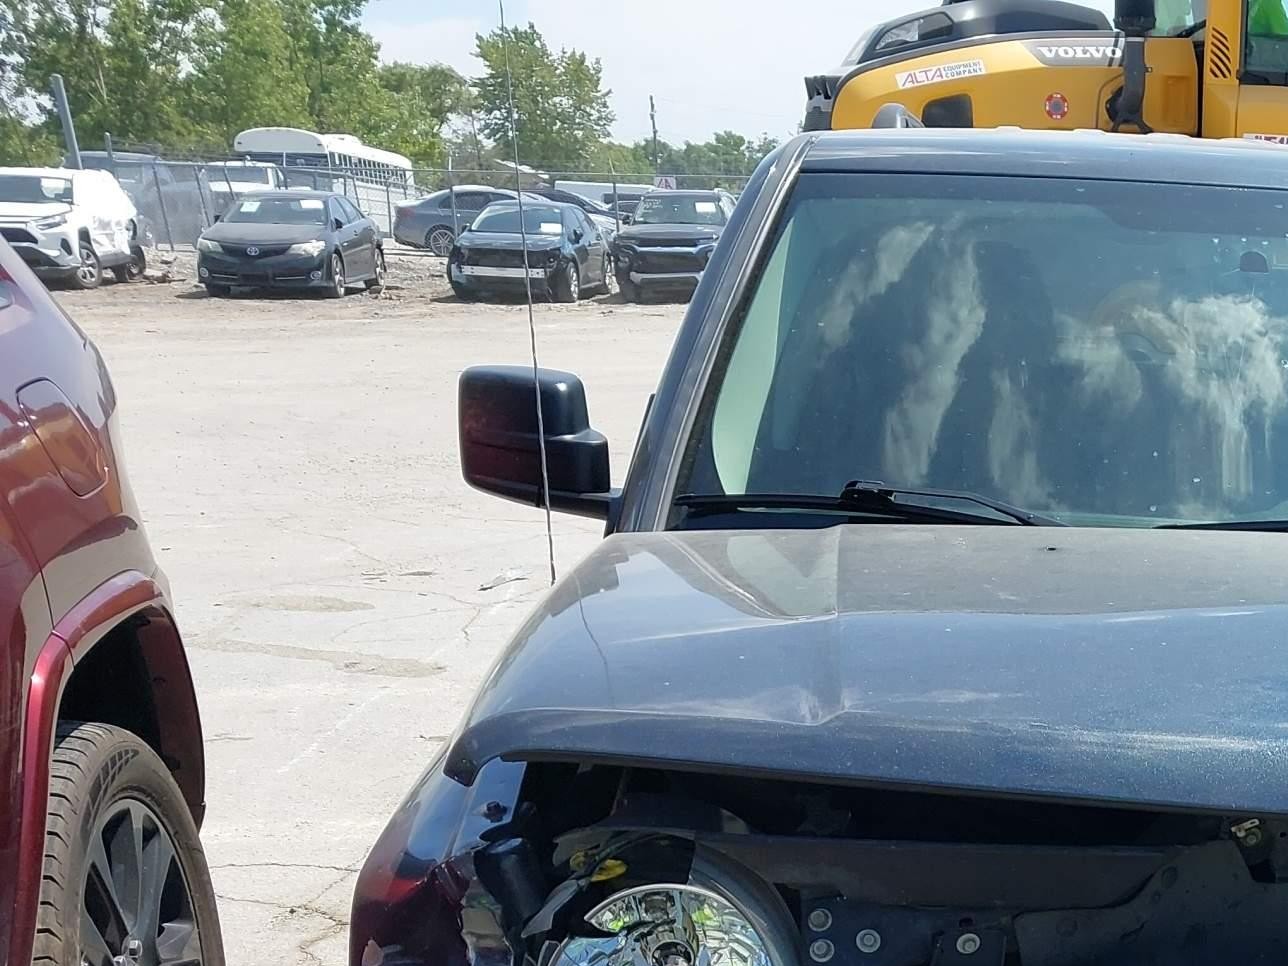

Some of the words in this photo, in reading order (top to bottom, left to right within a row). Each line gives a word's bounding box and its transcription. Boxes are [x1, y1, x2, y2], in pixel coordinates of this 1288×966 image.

[1037, 46, 1122, 58] VOLVO
[943, 60, 981, 72] EQUIPMENT
[902, 67, 944, 87] ALTA
[945, 67, 982, 79] COMPANY
